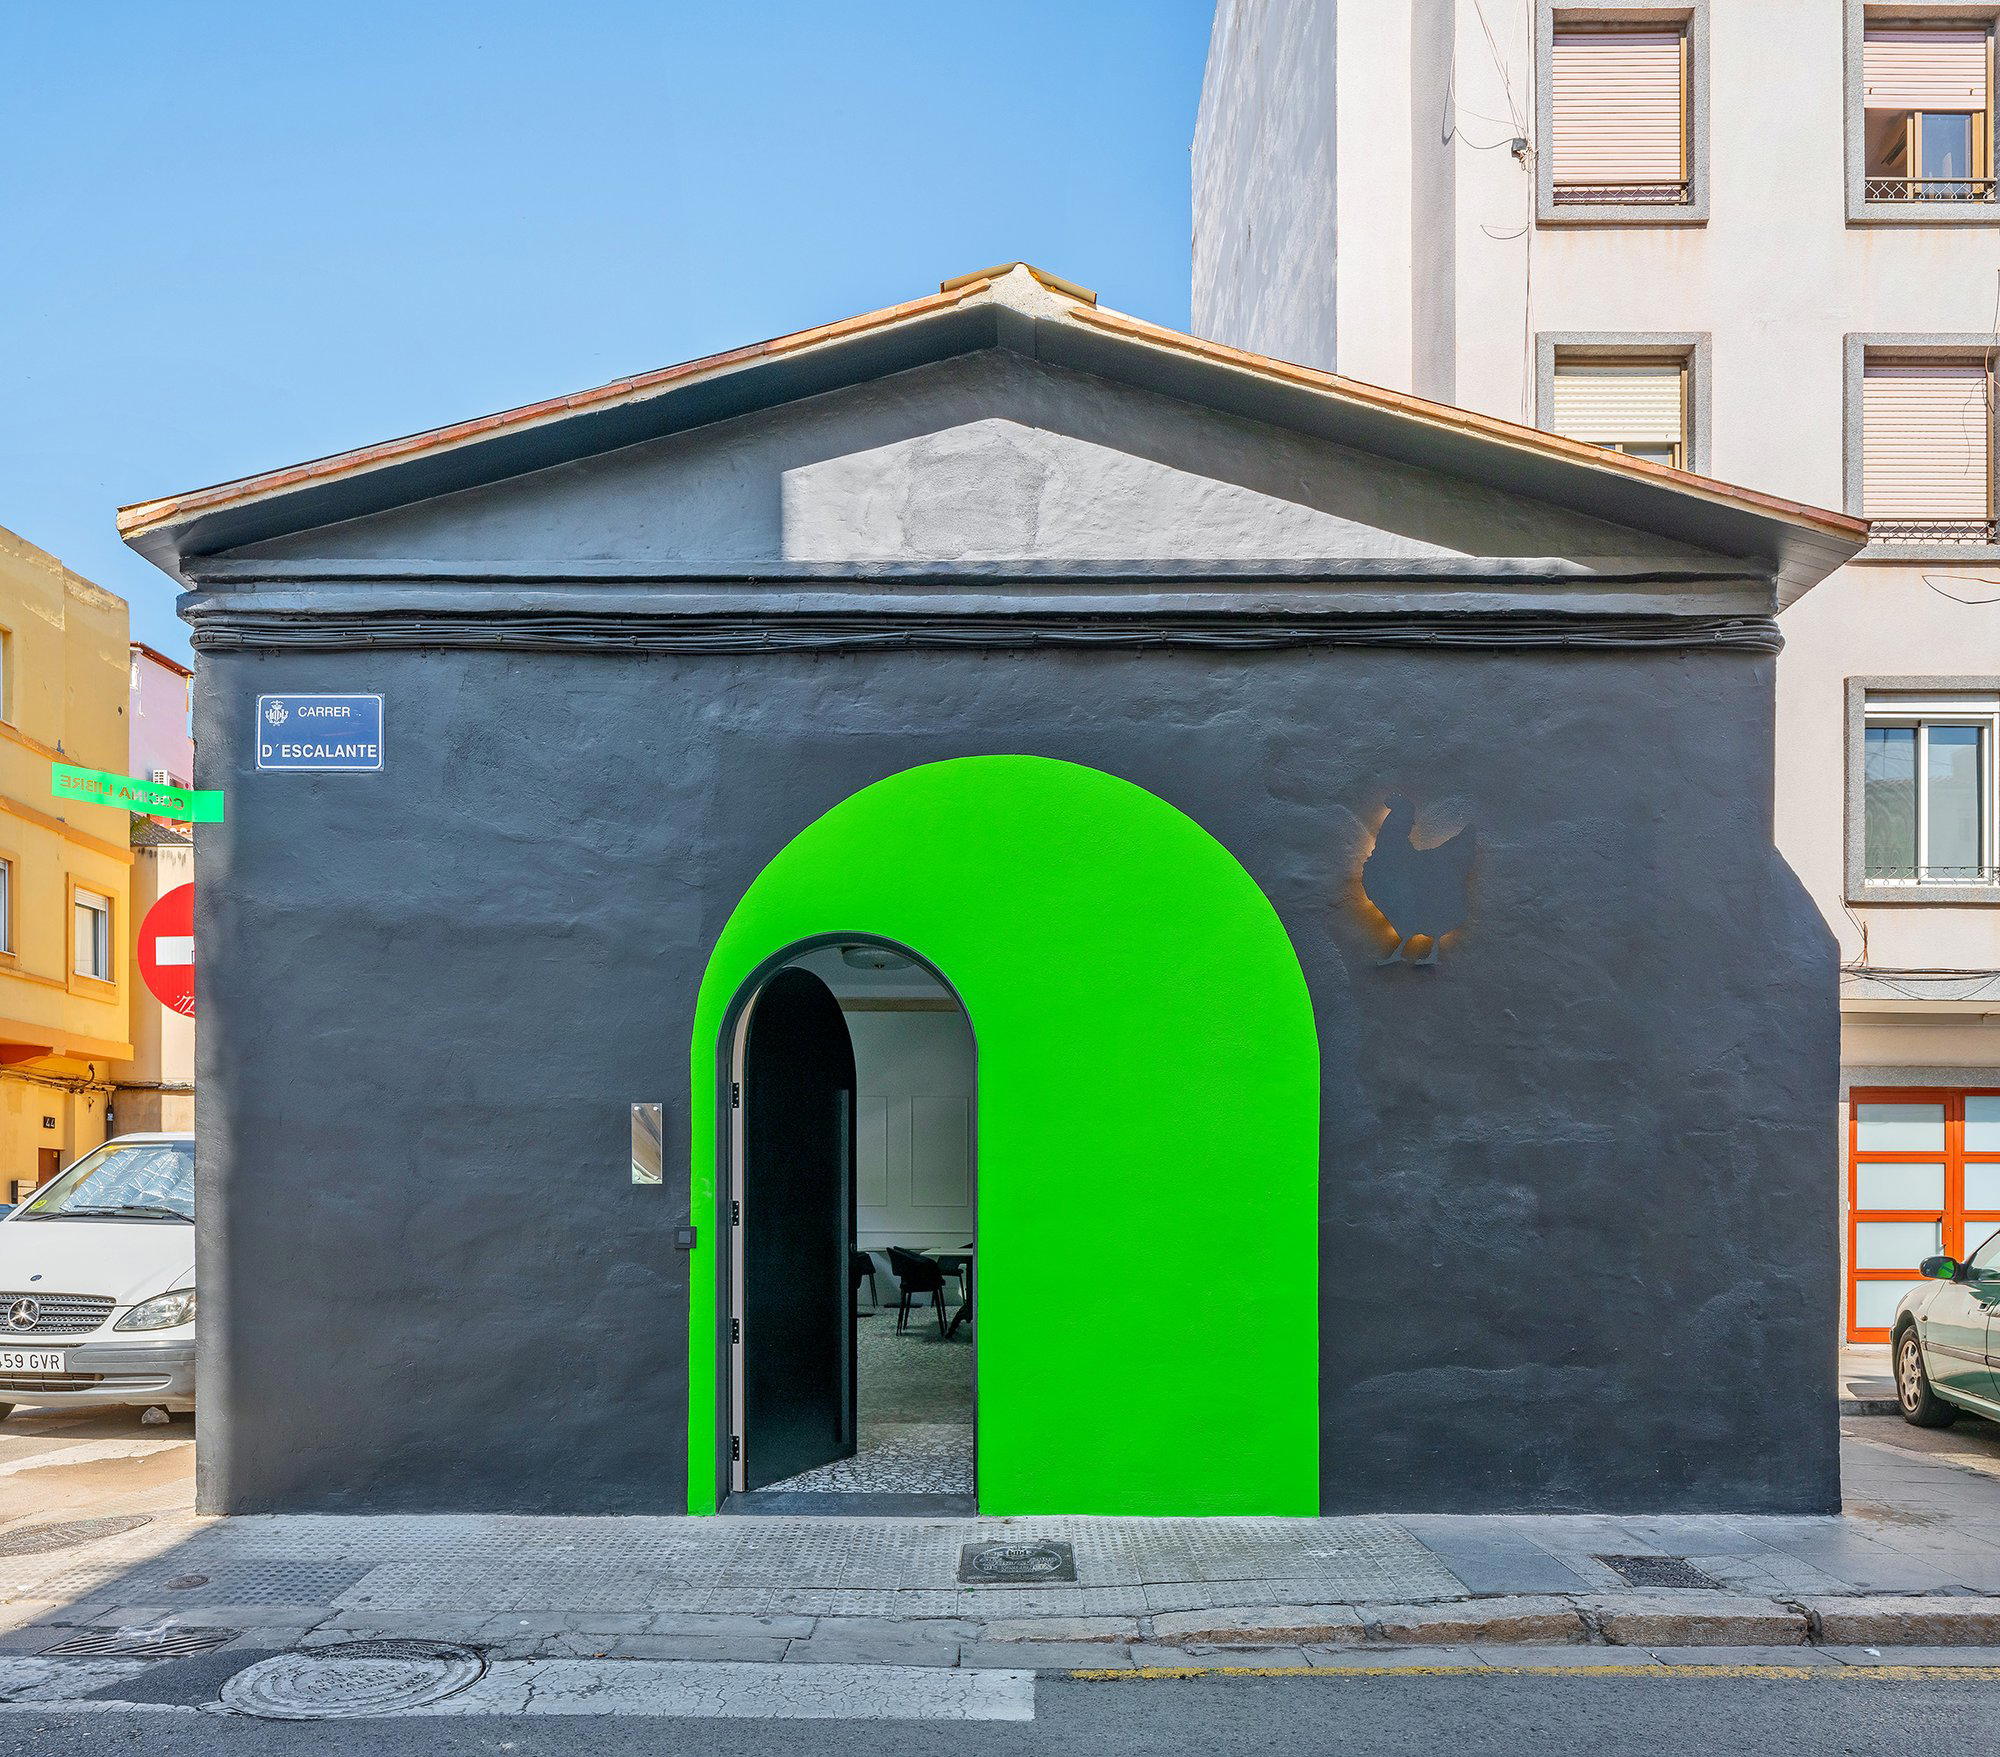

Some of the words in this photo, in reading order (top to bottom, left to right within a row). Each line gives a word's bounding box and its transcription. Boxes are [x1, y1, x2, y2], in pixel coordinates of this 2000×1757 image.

[298, 706, 351, 718] CARRER
[0, 1353, 24, 1368] 59
[29, 1354, 60, 1369] GVR
